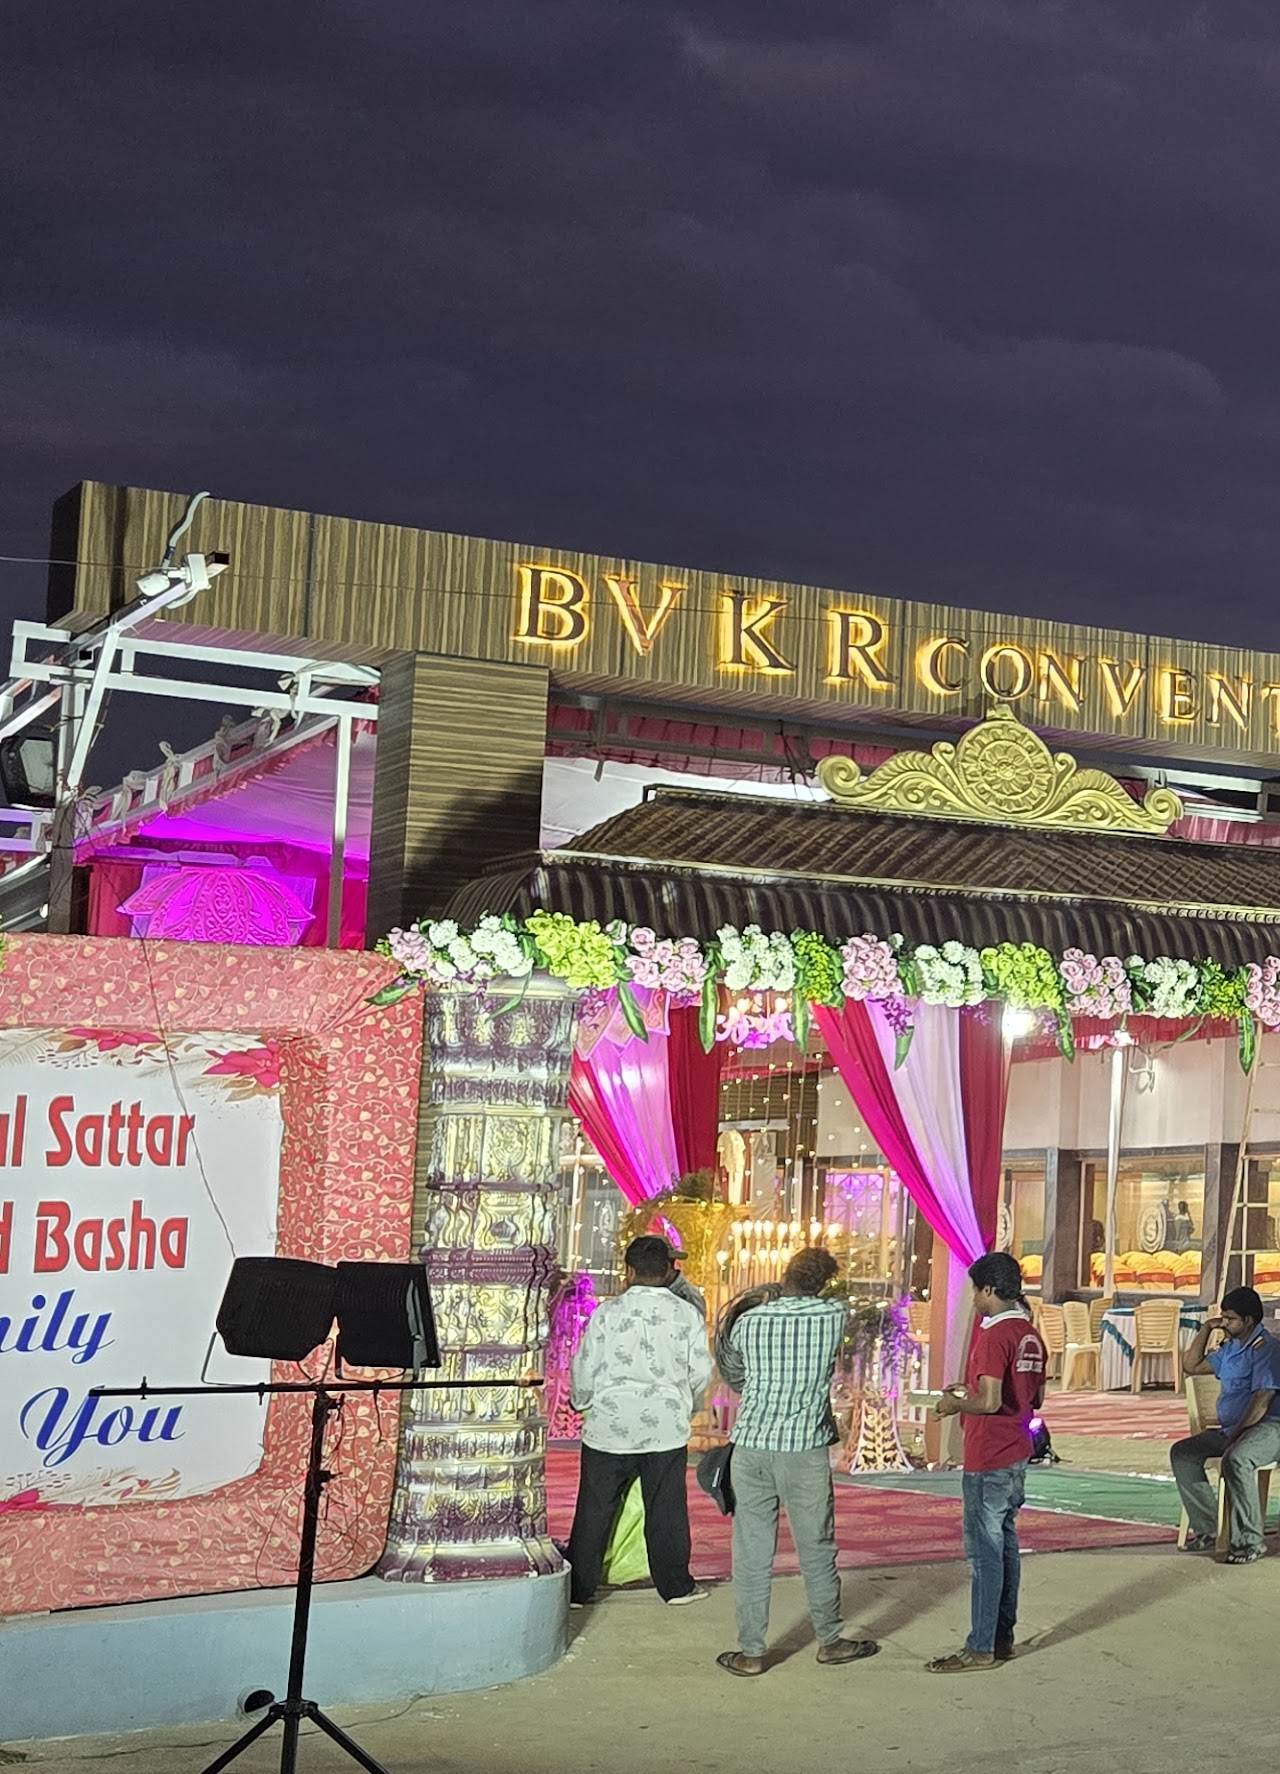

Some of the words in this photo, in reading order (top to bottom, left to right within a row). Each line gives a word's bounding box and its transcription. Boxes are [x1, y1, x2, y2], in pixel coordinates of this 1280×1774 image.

[46, 1096, 197, 1168] Sattar
[33, 1200, 190, 1274] Basha
[20, 1385, 187, 1468] You
